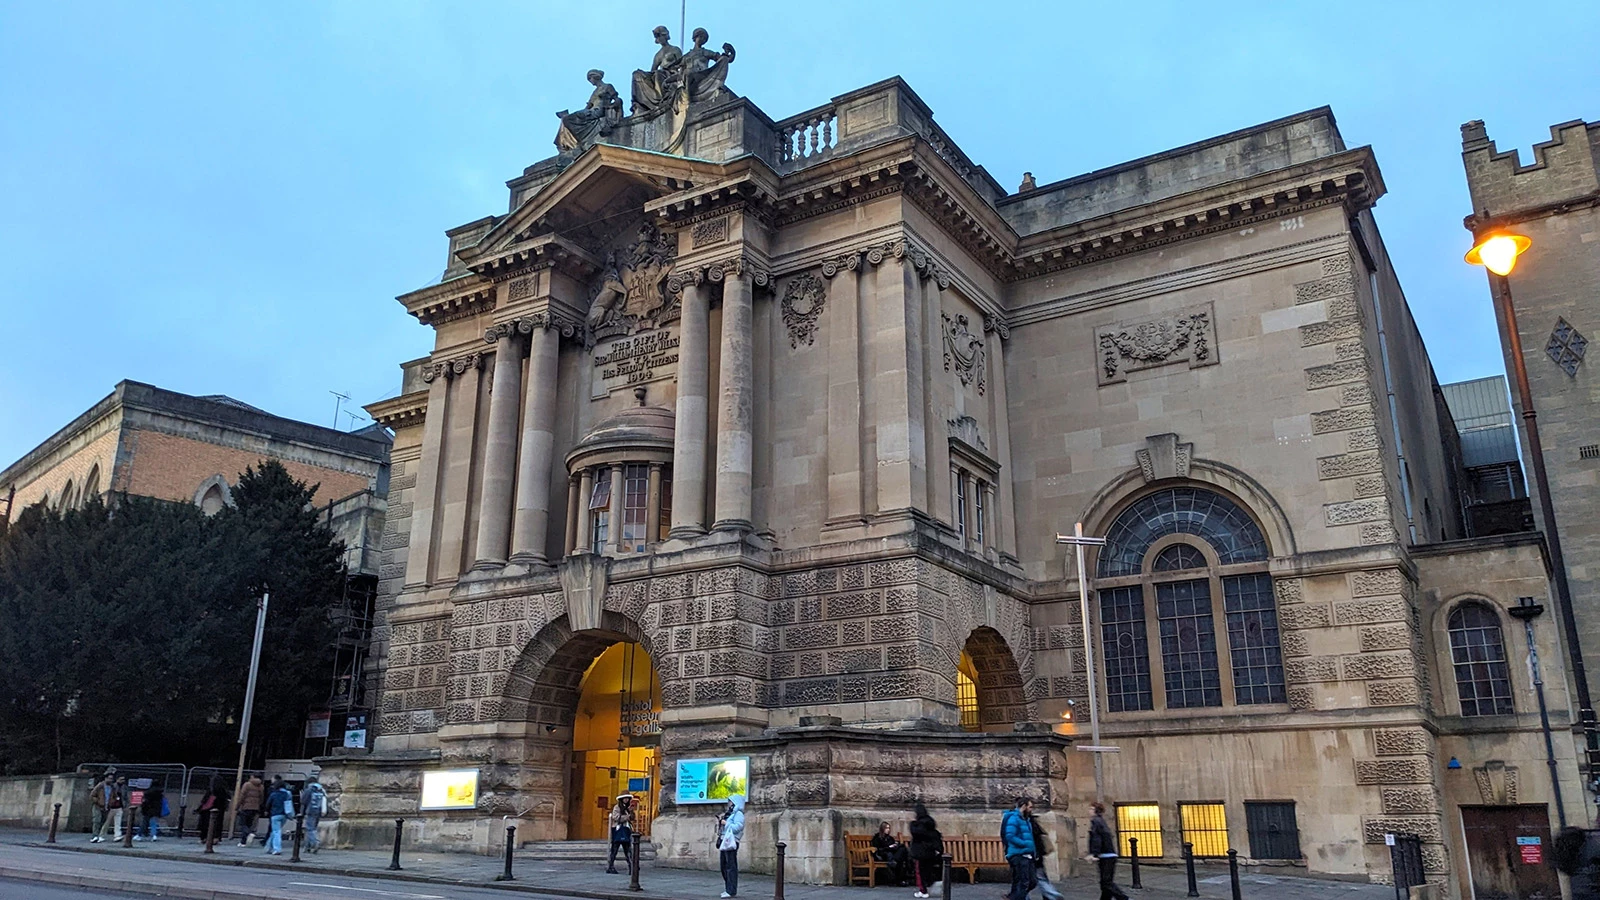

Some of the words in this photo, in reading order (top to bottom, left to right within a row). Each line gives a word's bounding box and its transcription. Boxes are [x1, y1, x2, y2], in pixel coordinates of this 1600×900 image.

[611, 341, 631, 353] THE
[633, 334, 656, 347] GIFT
[657, 330, 671, 341] OF
[607, 349, 634, 363] WILLIAM
[634, 343, 657, 356] HENRY
[633, 355, 649, 364] TO
[602, 369, 616, 380] HIS
[616, 361, 646, 377] FELLOW
[645, 354, 679, 370] CITIZENS
[626, 371, 654, 384] 1904
